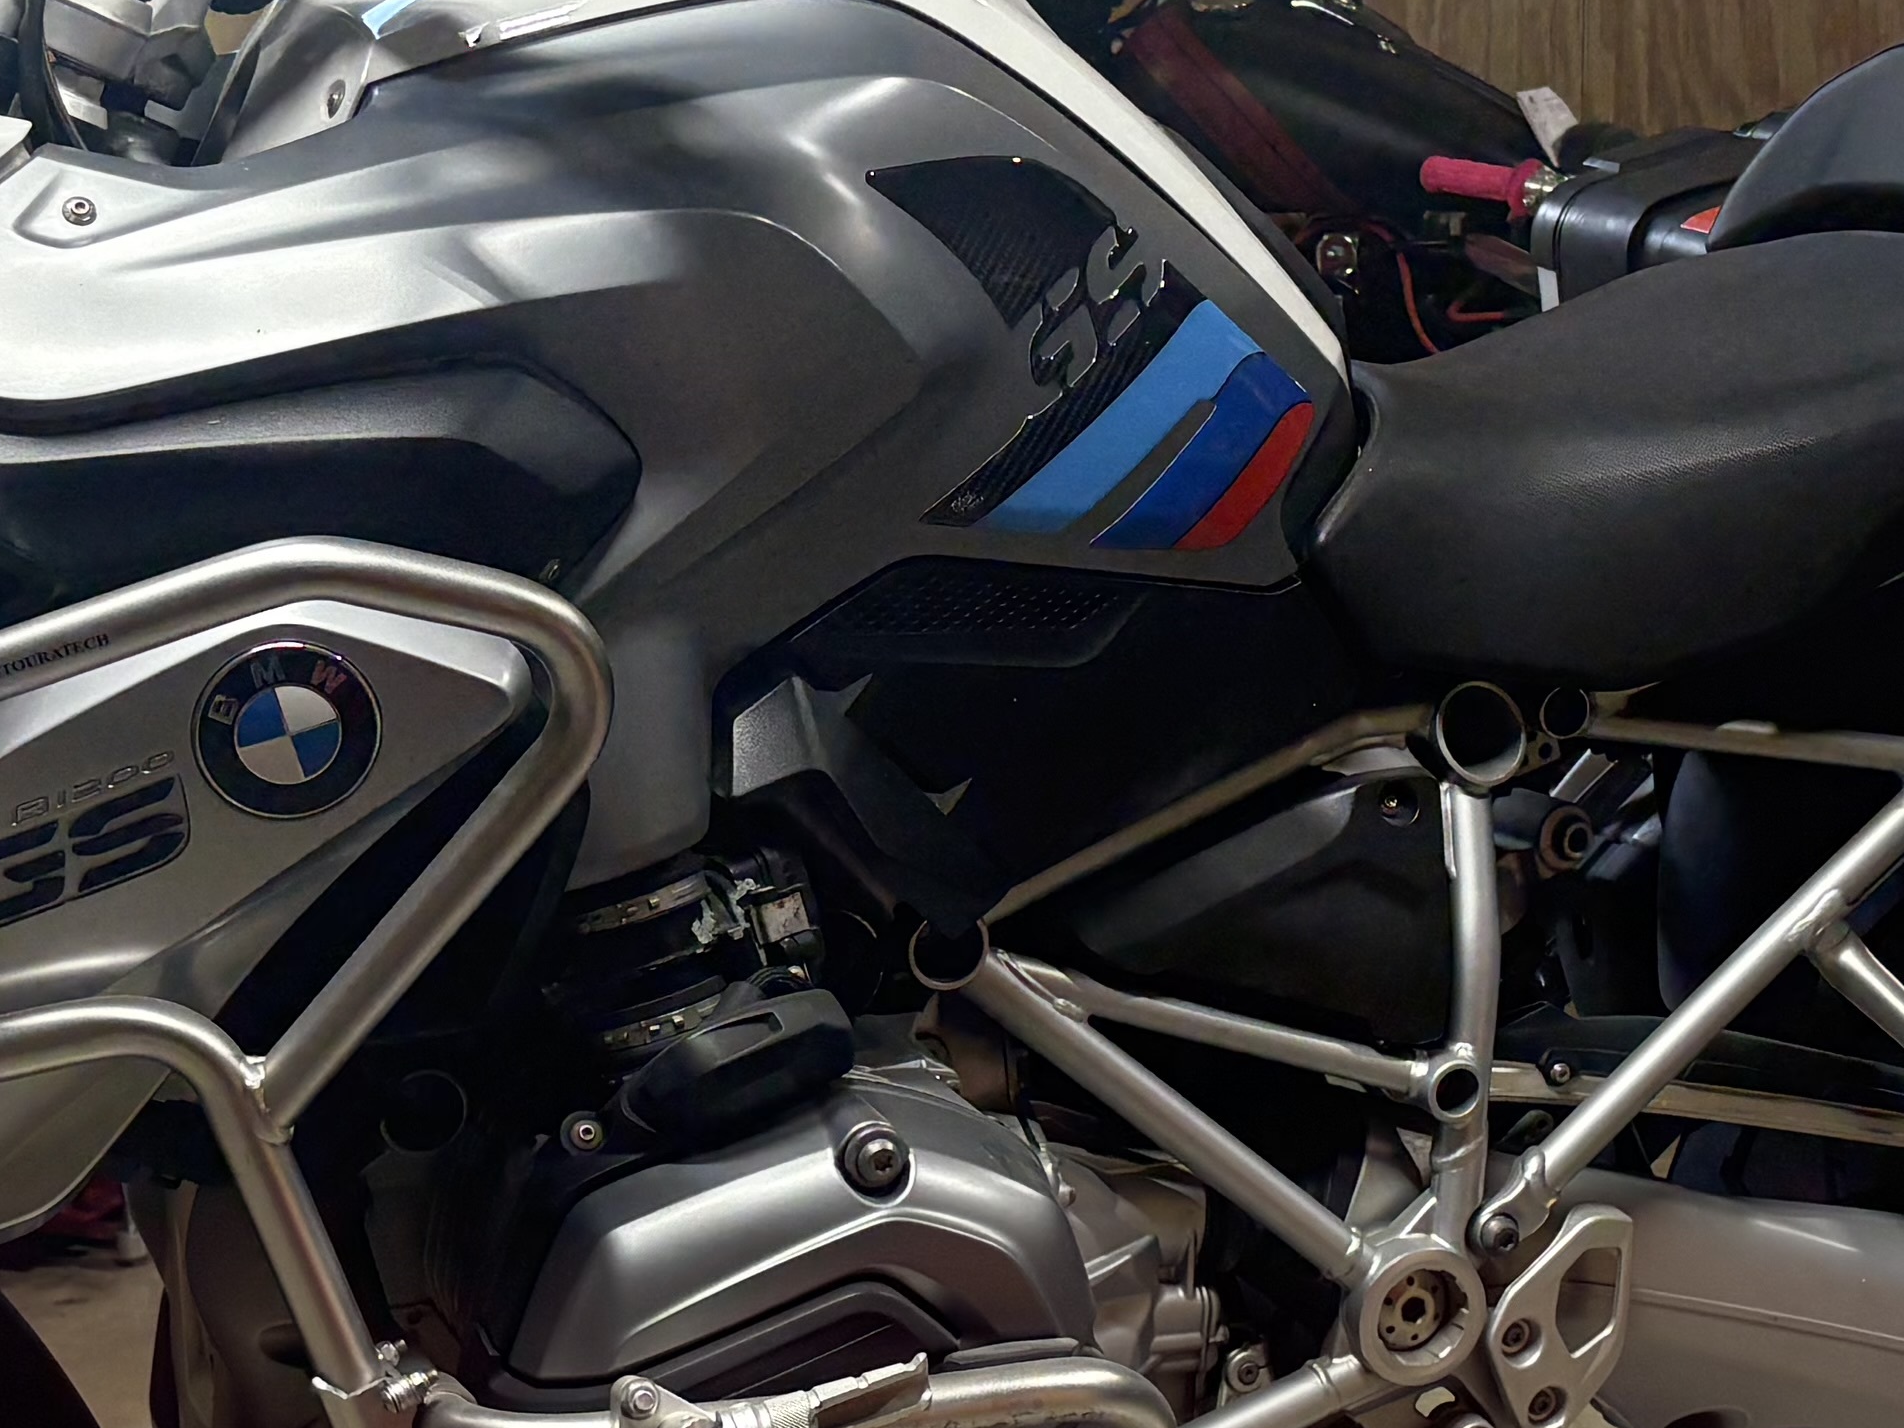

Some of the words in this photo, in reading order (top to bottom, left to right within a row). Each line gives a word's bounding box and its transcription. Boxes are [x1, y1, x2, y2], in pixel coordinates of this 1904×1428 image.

[0, 633, 110, 676] TOURATECH
[207, 654, 348, 726] BMW
[10, 750, 175, 828] R1200
